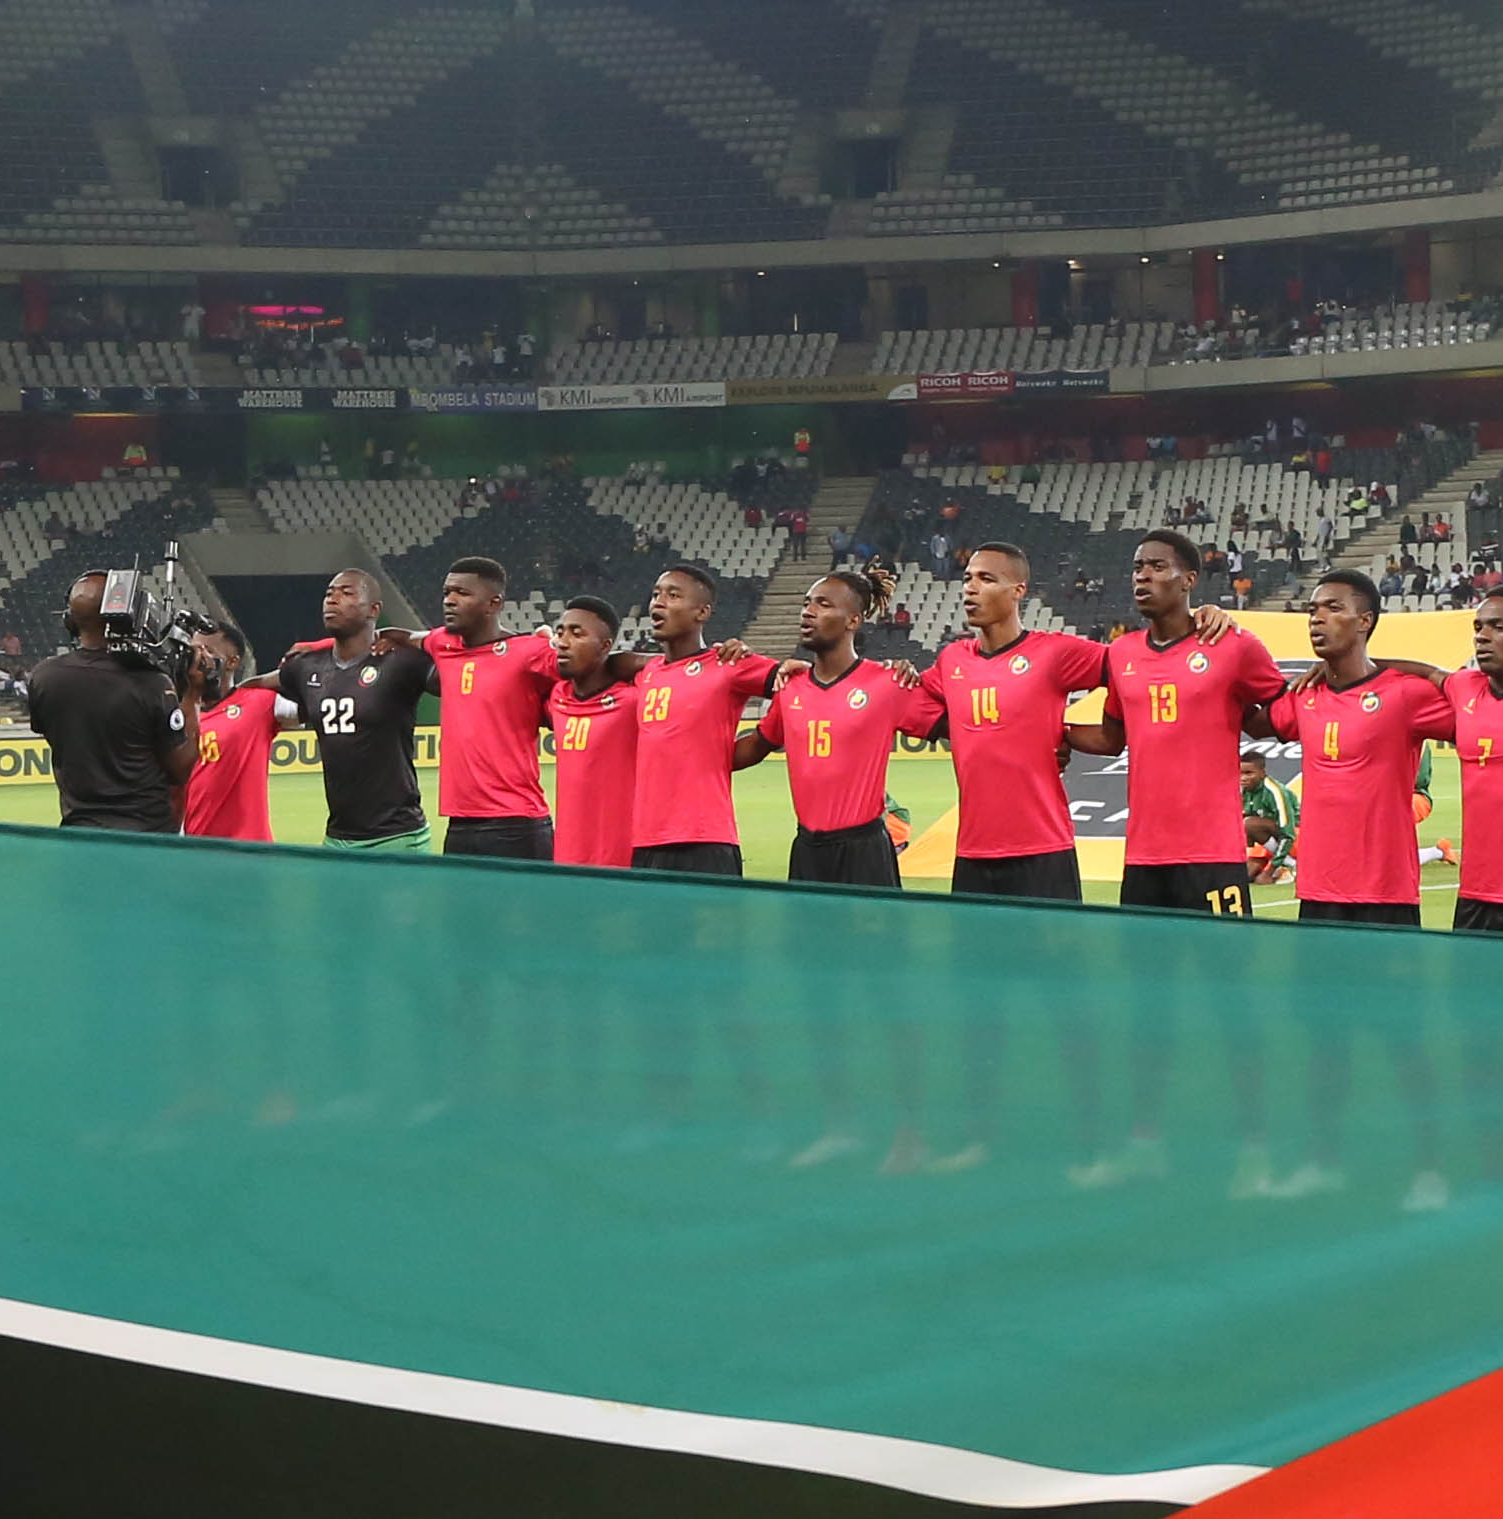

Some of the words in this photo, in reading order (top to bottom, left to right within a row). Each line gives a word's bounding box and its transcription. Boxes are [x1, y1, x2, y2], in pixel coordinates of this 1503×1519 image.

[337, 390, 395, 400] MATTRESS
[653, 387, 684, 403] KMI
[921, 377, 961, 387] RICOH
[968, 376, 1008, 386] RICOH
[333, 398, 396, 408] WAREHOUSE
[484, 392, 536, 406] STADIUM
[560, 390, 591, 405] KMI
[461, 661, 475, 695] 6
[320, 697, 356, 734] 22
[643, 686, 672, 722] 23
[971, 686, 1000, 726] 14
[1148, 684, 1178, 723] 13
[563, 717, 591, 751] 20
[807, 720, 832, 758] 15
[1323, 721, 1340, 761] 4
[1477, 737, 1494, 767] 7
[1206, 885, 1243, 917] 13
